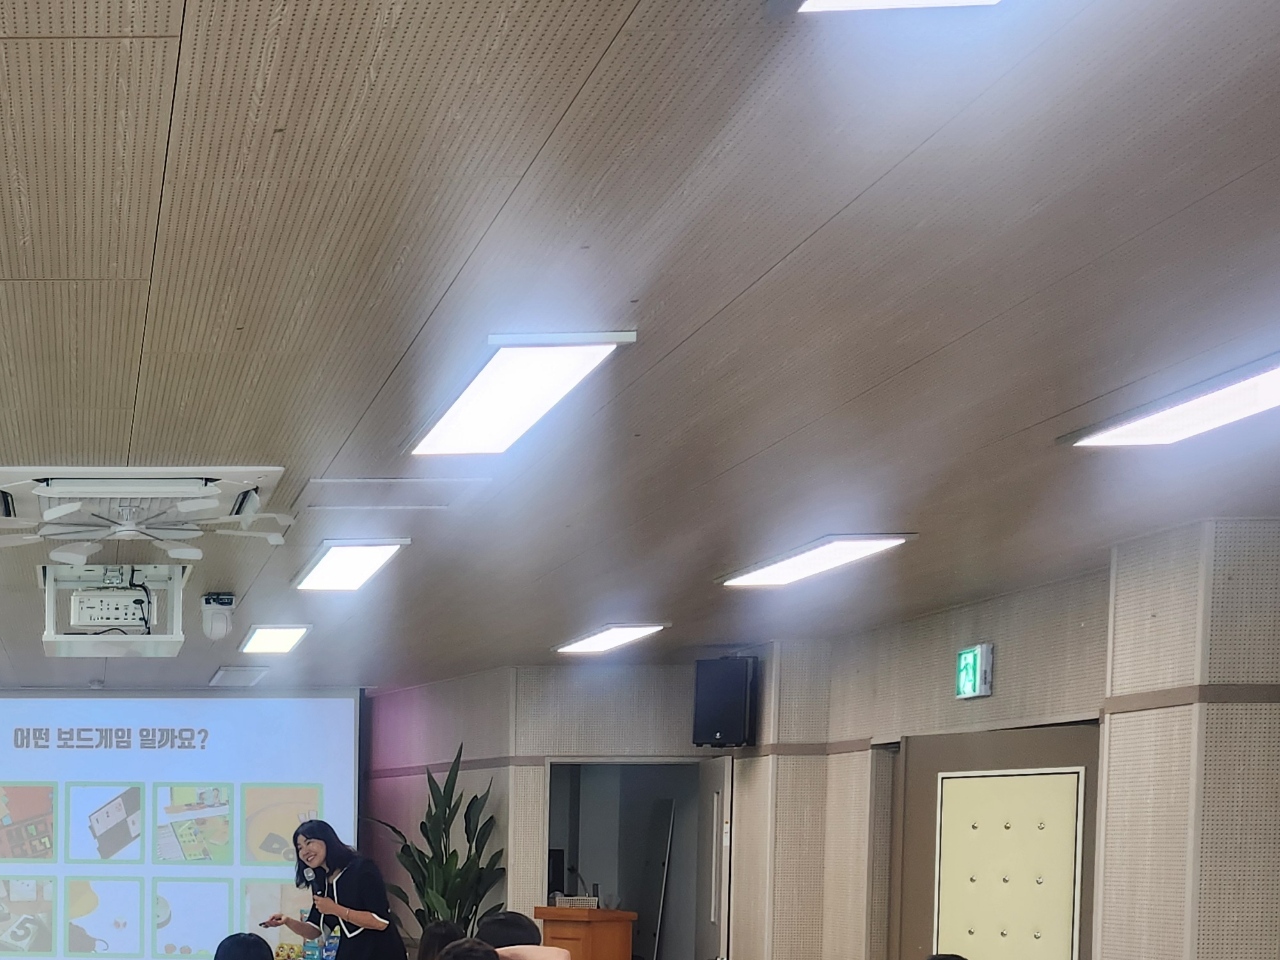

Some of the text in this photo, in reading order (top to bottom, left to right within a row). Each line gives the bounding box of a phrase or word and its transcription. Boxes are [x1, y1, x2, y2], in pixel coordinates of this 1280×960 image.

[13, 728, 210, 750] 어떤 보드게임 일까요?
[9, 917, 36, 942] 5
